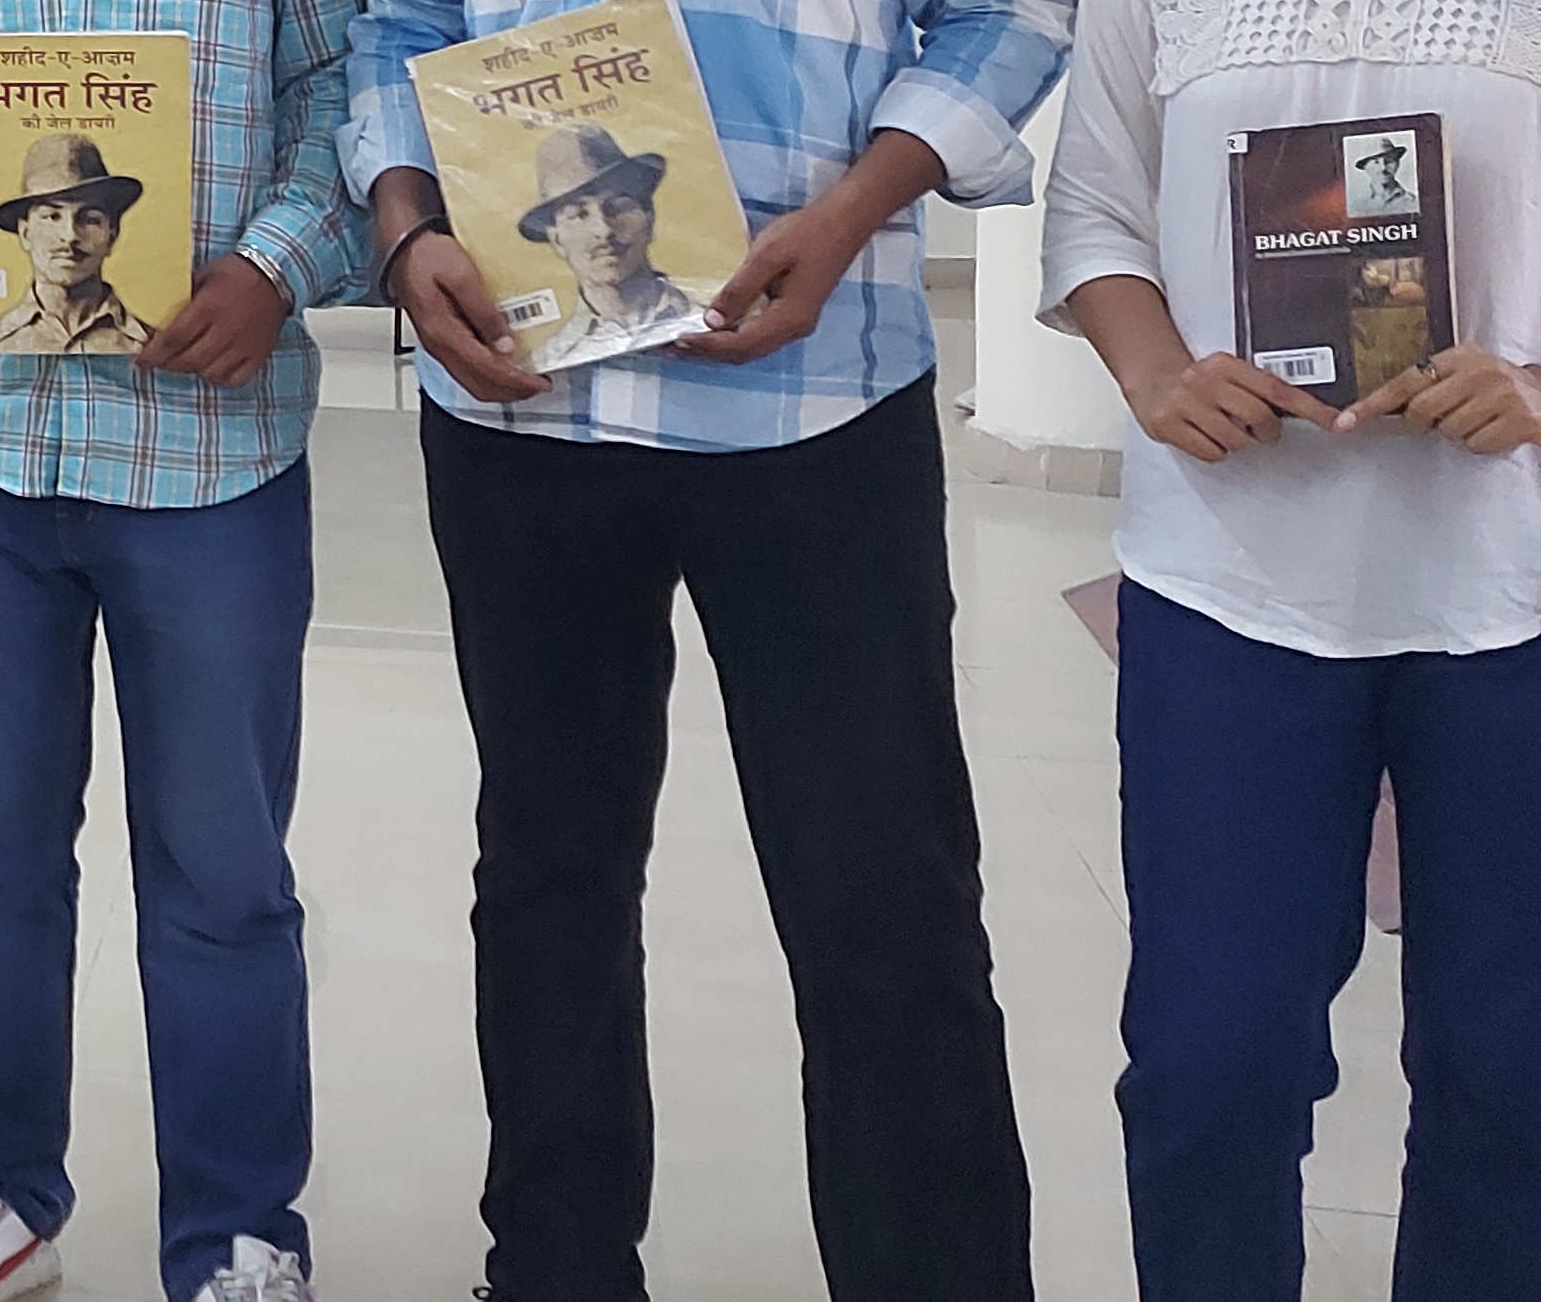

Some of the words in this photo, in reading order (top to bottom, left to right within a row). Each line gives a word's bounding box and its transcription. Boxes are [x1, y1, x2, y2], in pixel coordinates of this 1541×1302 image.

[80, 72, 158, 114] सिंह
[473, 73, 562, 116] भगत
[571, 47, 651, 93] सिंह
[21, 113, 41, 129] की
[45, 114, 72, 129] जेल
[75, 114, 115, 129] डायरी
[1255, 229, 1343, 251] BHAGAT
[1346, 224, 1417, 245] SINGH
